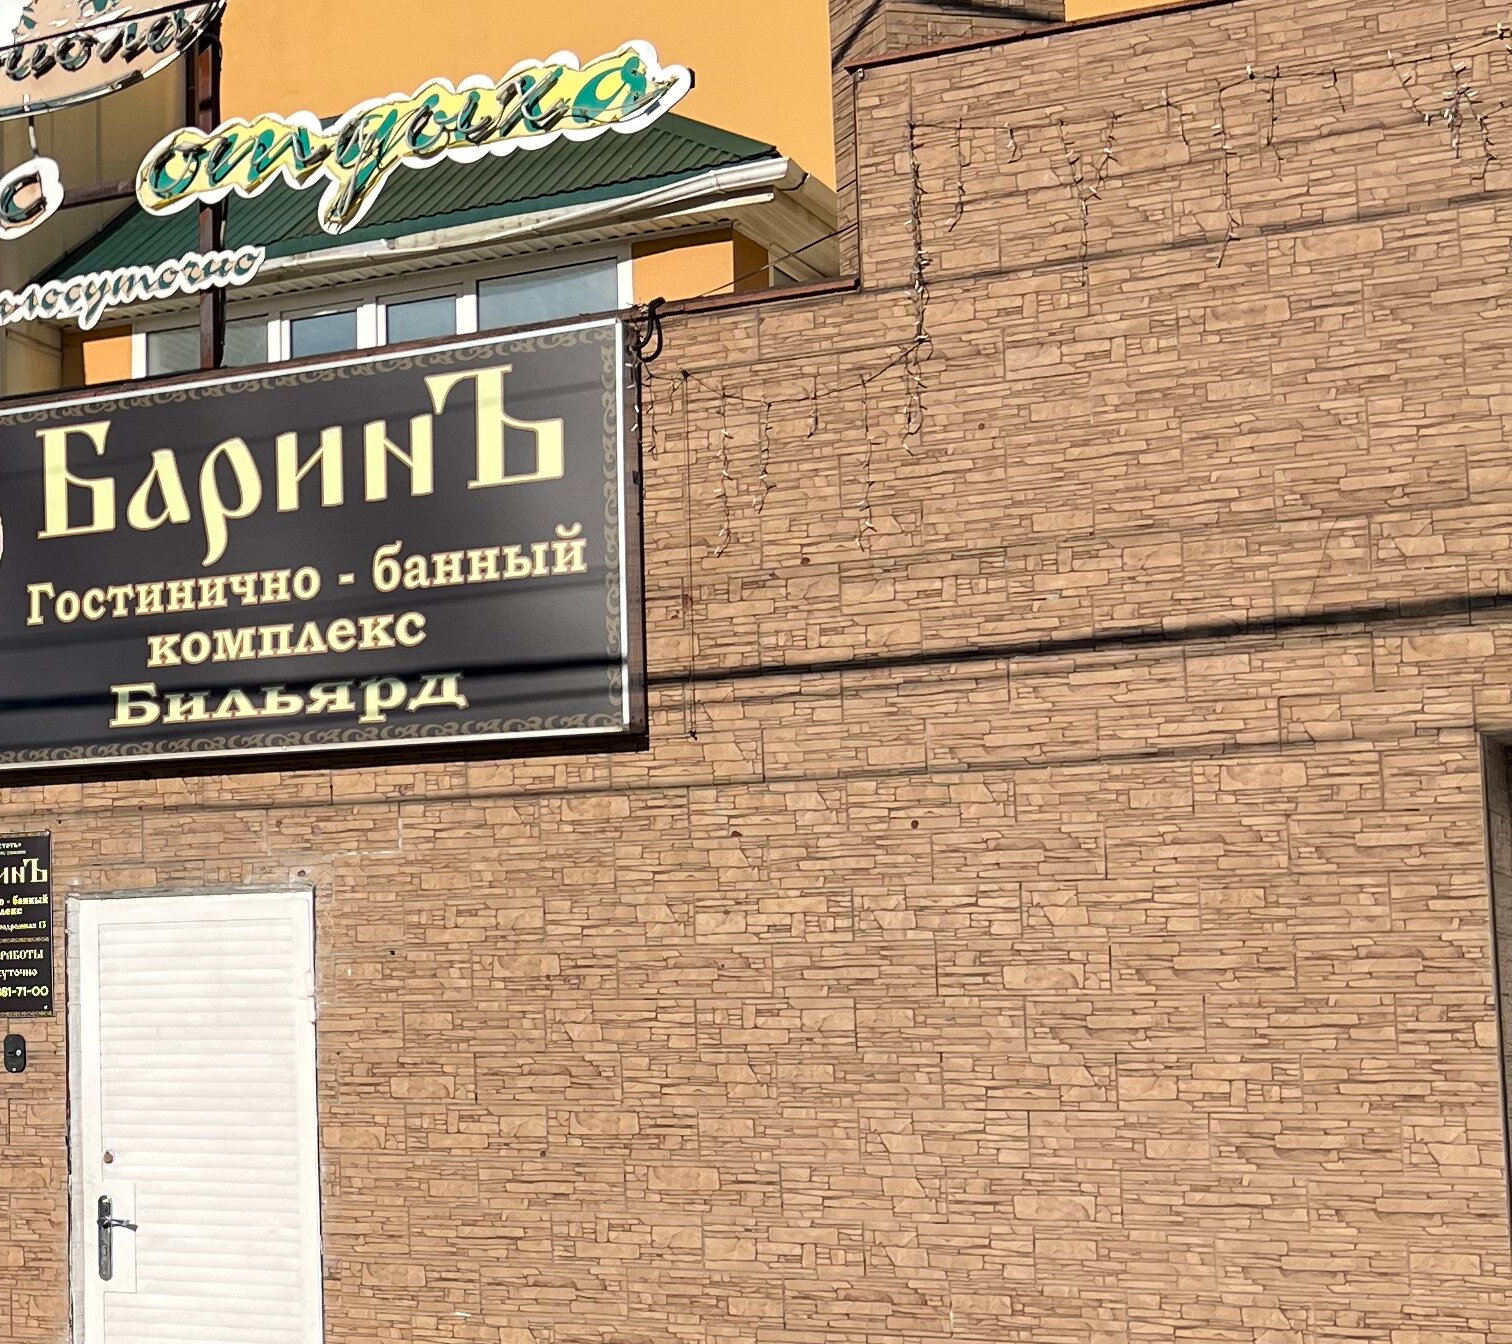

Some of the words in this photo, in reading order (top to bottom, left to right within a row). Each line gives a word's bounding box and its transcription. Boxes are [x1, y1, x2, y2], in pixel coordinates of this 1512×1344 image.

[144, 48, 682, 226] отдыха
[35, 364, 565, 567] БаринЪ
[26, 567, 321, 625] Гостинично
[372, 521, 588, 591] банный
[147, 611, 427, 668] комплекс
[109, 671, 471, 728] Бильярд
[12, 894, 48, 905] банный
[0, 949, 44, 961] РАБОТЫ
